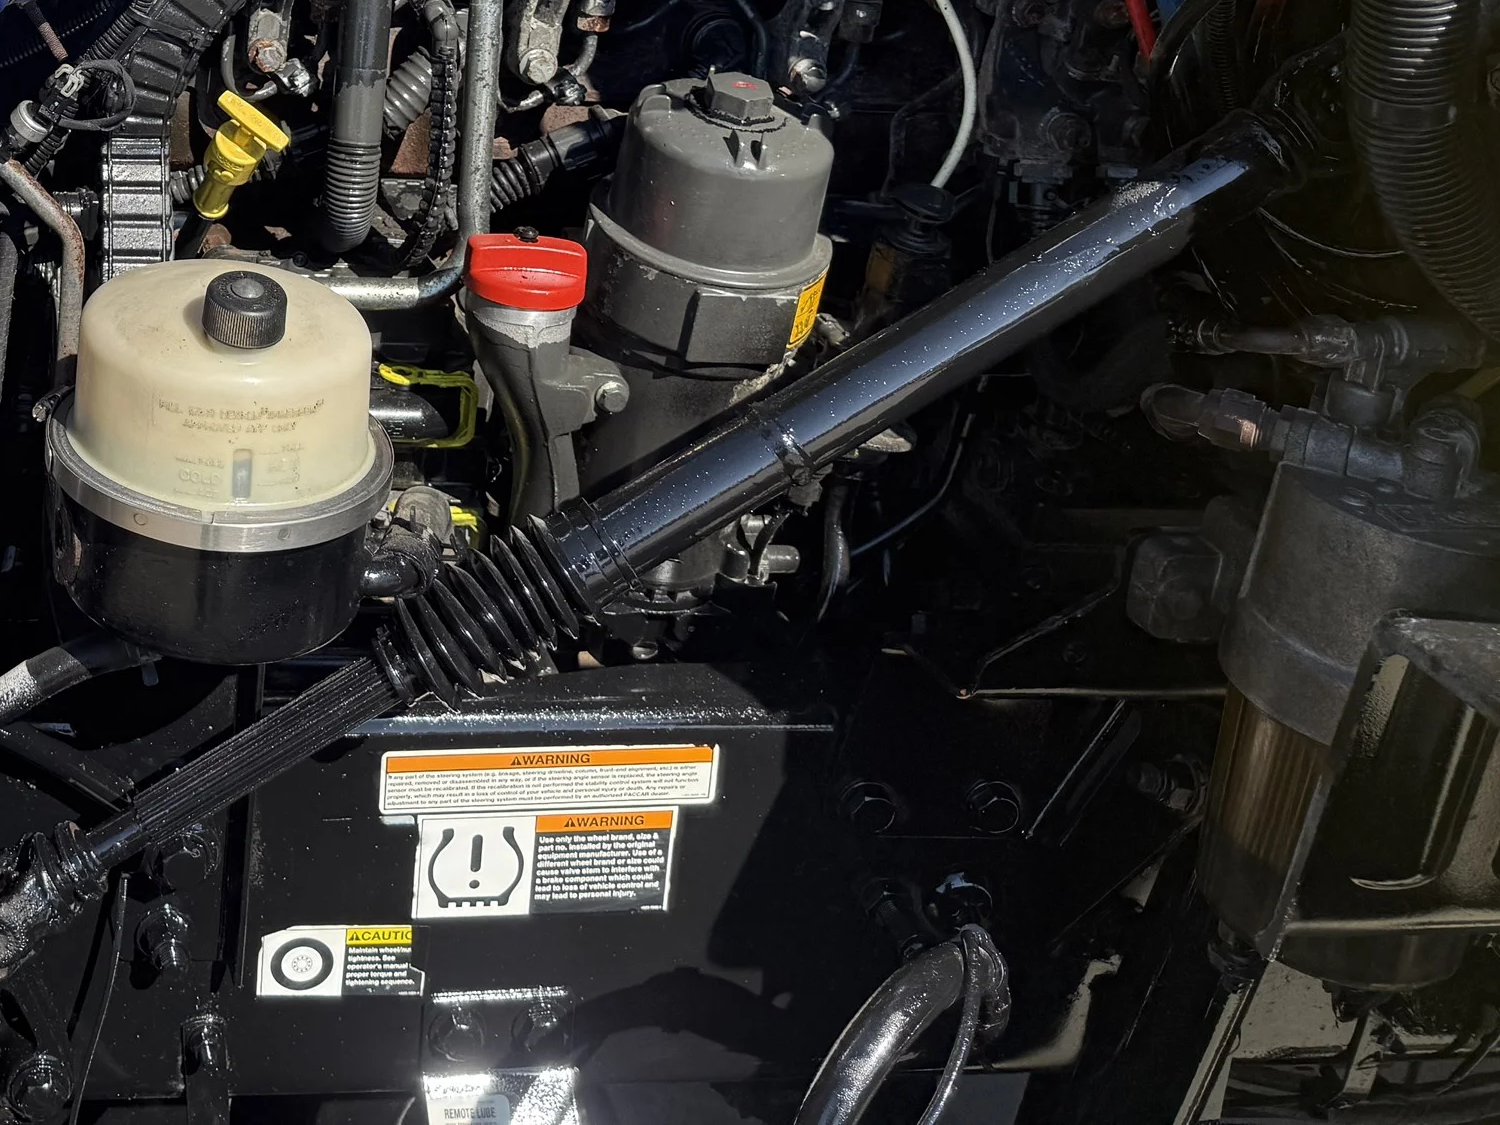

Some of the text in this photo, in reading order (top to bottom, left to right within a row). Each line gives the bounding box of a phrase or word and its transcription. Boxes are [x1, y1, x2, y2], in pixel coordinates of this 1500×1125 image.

[523, 754, 591, 765] WARNING
[577, 816, 644, 827] WARNING
[627, 841, 655, 849] original
[538, 852, 577, 860] equipment
[579, 850, 630, 858] manufacturer.
[565, 875, 607, 883] component
[589, 882, 615, 890] vehicle
[535, 893, 551, 901] may
[579, 891, 611, 899] personal
[613, 890, 636, 898] injury.
[362, 931, 412, 940] CAUTIO
[444, 1107, 497, 1120] REMOTE LUBE
